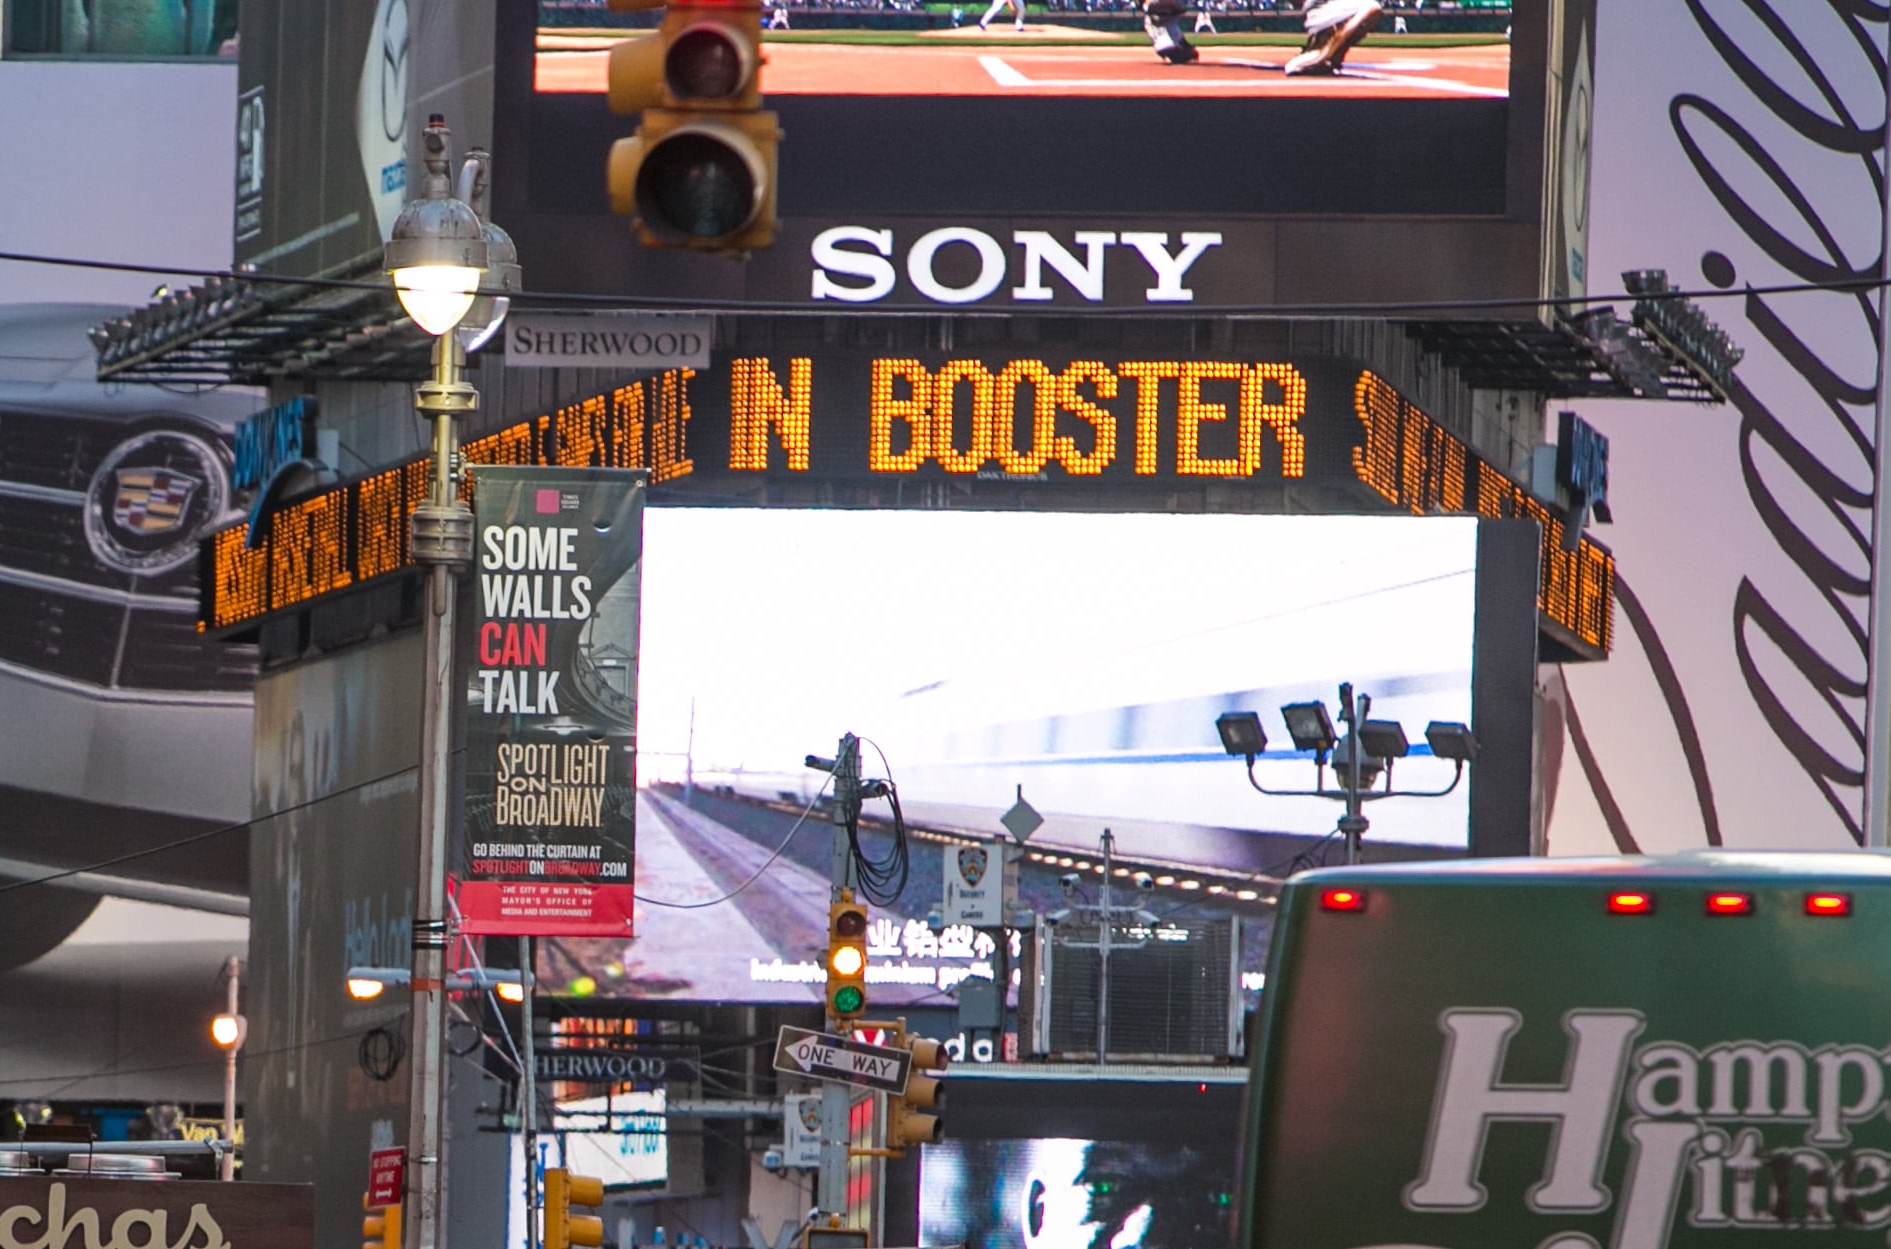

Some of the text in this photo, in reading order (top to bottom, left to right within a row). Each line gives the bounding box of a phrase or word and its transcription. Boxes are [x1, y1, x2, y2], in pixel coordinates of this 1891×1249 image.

[811, 226, 1222, 302] SONY
[513, 325, 702, 357] SHERWOOD
[729, 357, 811, 470] IN
[869, 357, 1307, 477] BOOSTER
[482, 525, 579, 571] SOME
[481, 574, 592, 620] WALLS
[479, 621, 547, 666] CAN
[478, 669, 560, 714] TALK
[496, 743, 611, 785] SPOTLIGHT
[510, 776, 547, 792] ON
[496, 785, 605, 827] BROADWAY
[473, 843, 601, 859] GO BEHIND THE CURTAIN AT
[472, 860, 627, 877] SPOTLIGHTONBROADWAY.COM
[501, 897, 593, 906] MAYOR'S OFFICE OF
[503, 886, 516, 894] THE
[520, 886, 537, 894] CITY
[540, 886, 549, 894] OF
[553, 887, 569, 895] NEW
[501, 907, 592, 917] MEDIA AND ENTERTAINMENT
[534, 1054, 667, 1078] HERWOOD
[798, 1043, 892, 1077] ONE WAY
